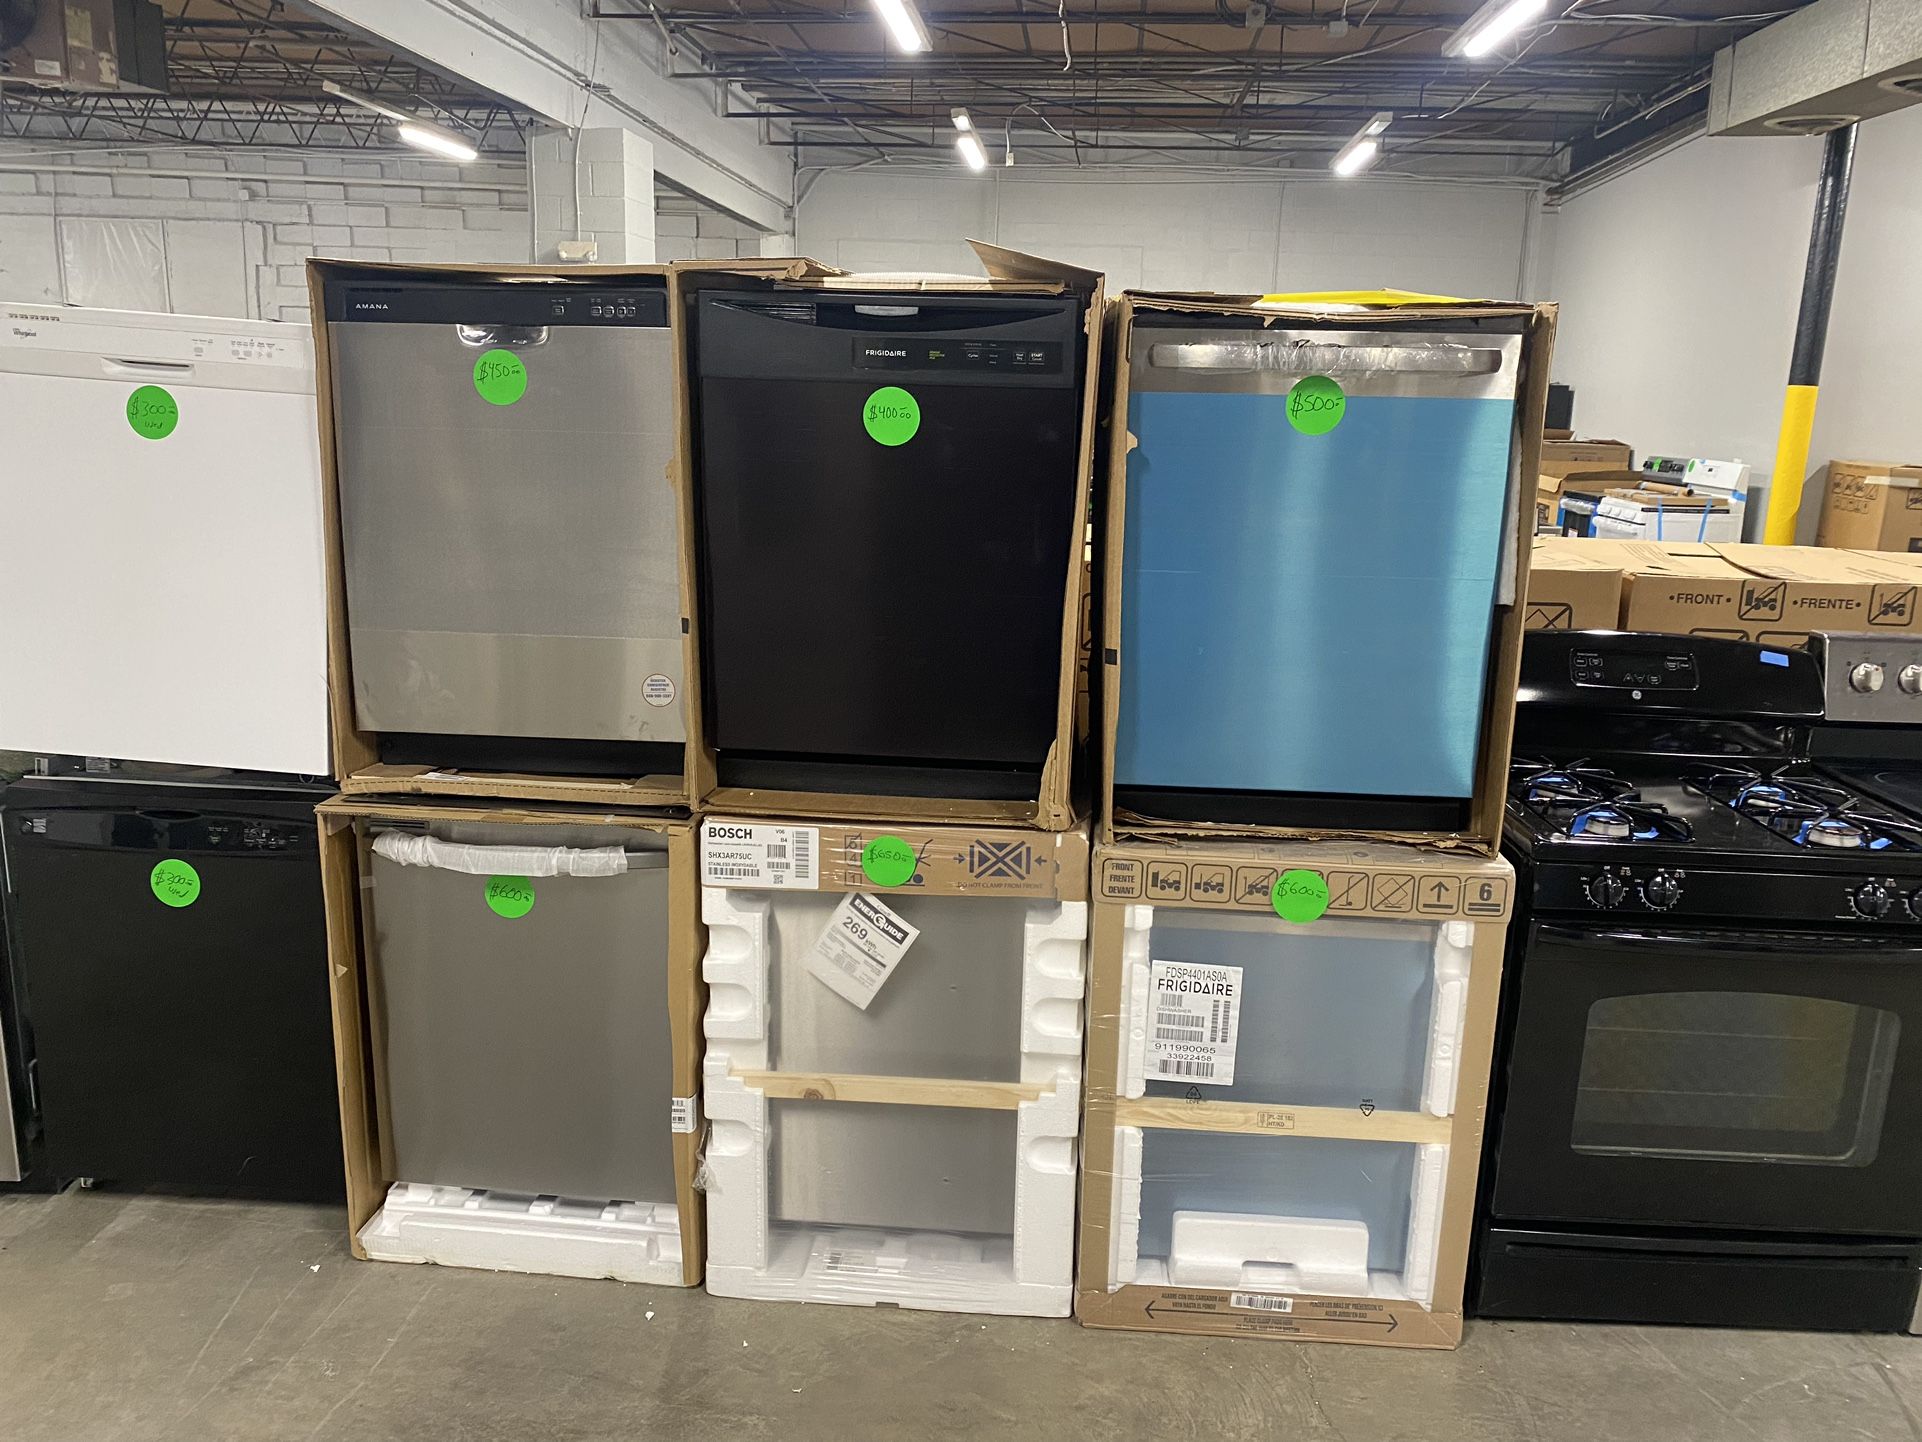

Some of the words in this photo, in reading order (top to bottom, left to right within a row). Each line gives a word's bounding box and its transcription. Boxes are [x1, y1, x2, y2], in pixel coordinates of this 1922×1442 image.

[865, 349, 907, 357] FRIGIDAIRE
[1677, 592, 1724, 605] FRONT
[1800, 598, 1854, 610] FRENTE
[708, 827, 753, 840] BOSCH
[1111, 863, 1134, 871] FRONT
[1110, 874, 1135, 883] FRENTE
[1108, 886, 1135, 895] DEVANT
[1479, 882, 1493, 902] 6
[842, 916, 868, 940] 269
[1157, 979, 1233, 996] FRIGIDAIRE
[1156, 1006, 1192, 1014] DISHWASHER
[1154, 1043, 1216, 1054] 911990065
[1166, 1052, 1212, 1062] 33922458
